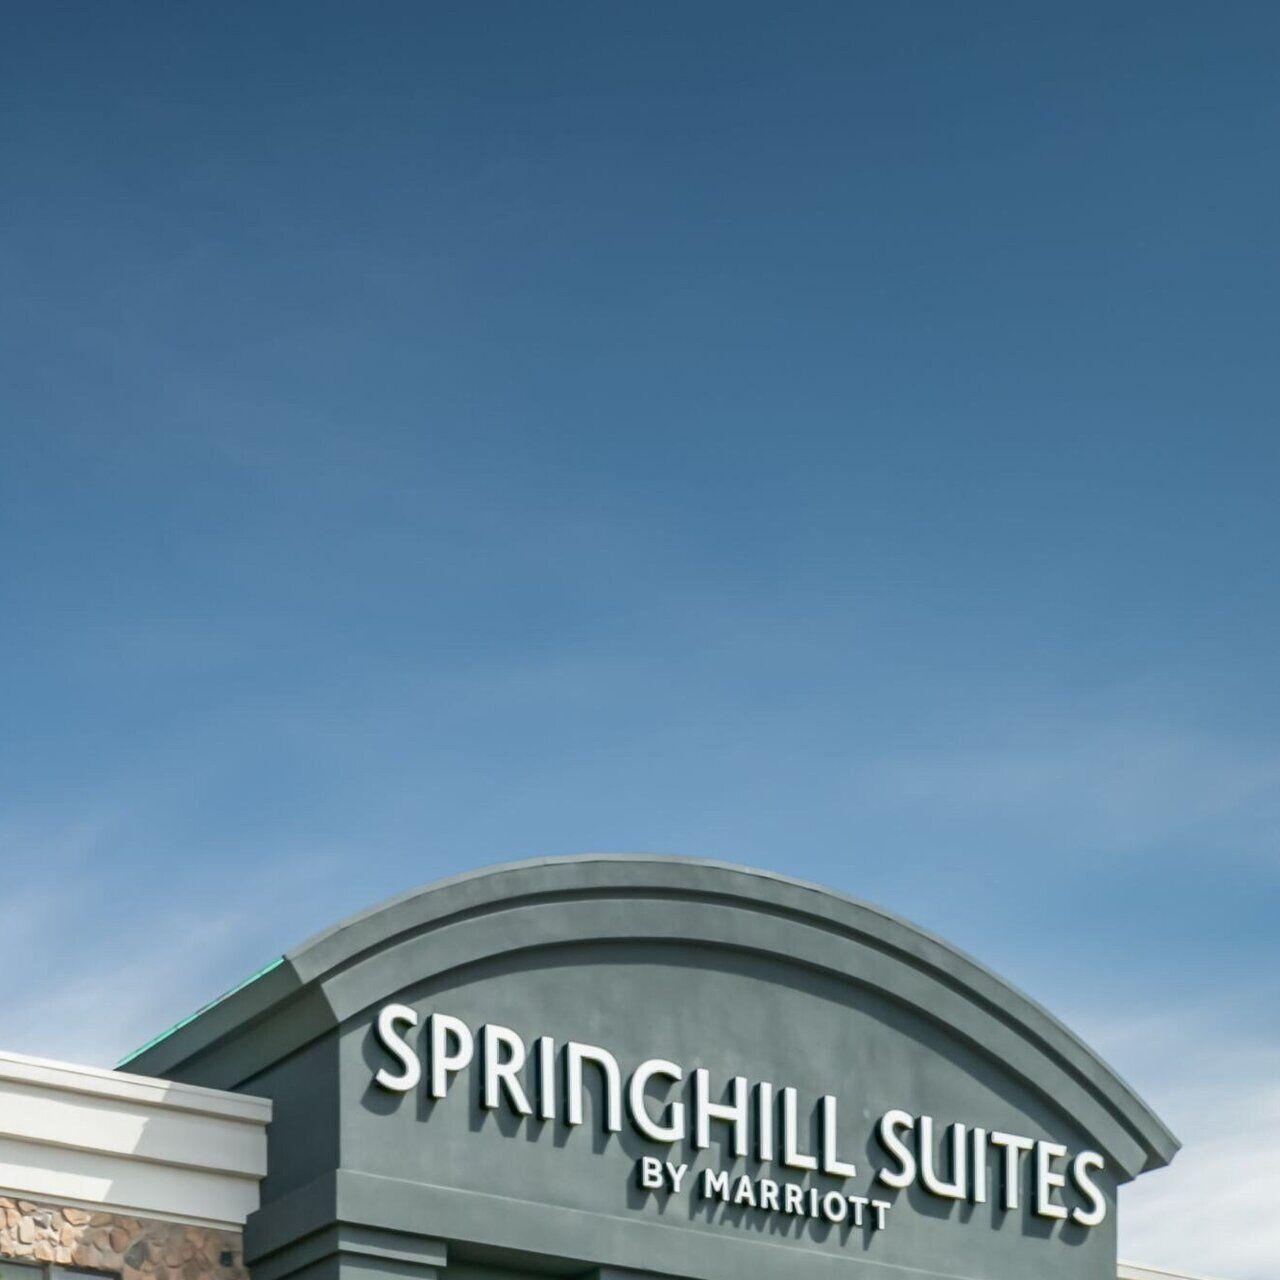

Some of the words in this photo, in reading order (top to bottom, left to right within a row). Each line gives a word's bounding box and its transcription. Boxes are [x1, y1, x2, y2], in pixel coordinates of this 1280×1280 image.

[375, 1003, 857, 1178] SPRINGHILL
[879, 1108, 1107, 1227] SUITES
[642, 1155, 688, 1193] BY
[705, 1168, 892, 1231] MARRIOTT
